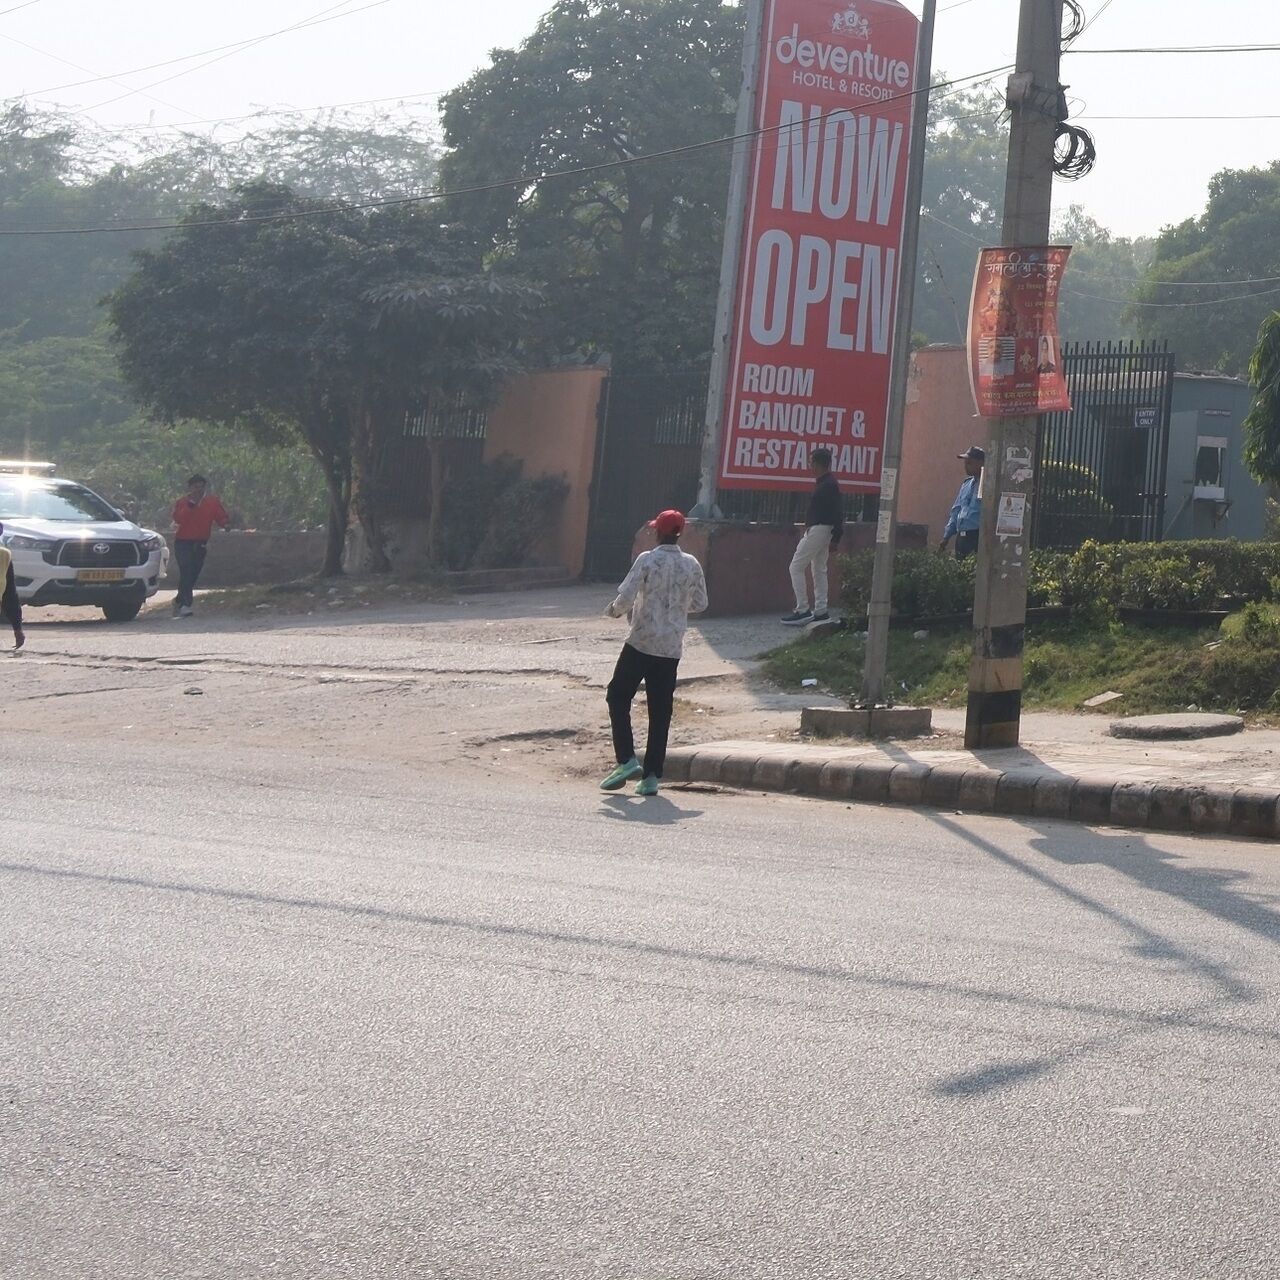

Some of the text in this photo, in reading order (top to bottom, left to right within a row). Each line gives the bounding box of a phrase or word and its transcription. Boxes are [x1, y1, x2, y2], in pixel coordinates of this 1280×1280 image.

[776, 23, 909, 88] deventure
[793, 71, 895, 103] HOTEL & RESORT
[771, 100, 903, 226] NOW
[750, 229, 895, 355] OPEN
[743, 363, 815, 397] ROOM
[739, 400, 866, 438] BANQUET &
